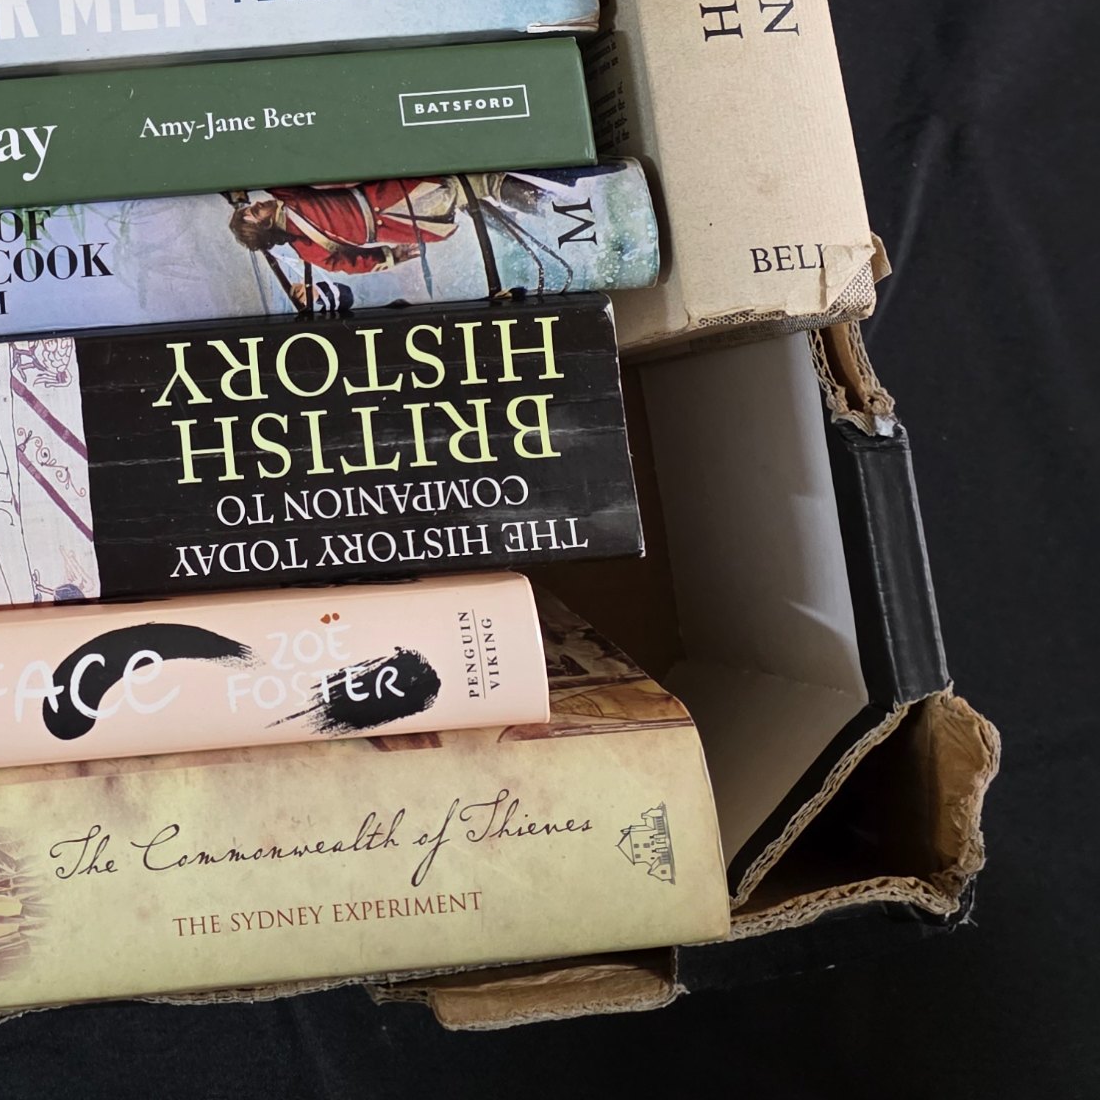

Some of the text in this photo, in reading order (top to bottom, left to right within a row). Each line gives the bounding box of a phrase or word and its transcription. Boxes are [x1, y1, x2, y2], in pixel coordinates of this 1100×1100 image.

[139, 107, 316, 143] Amy-Jane Beer
[414, 96, 515, 115] BATSFORD
[558, 199, 598, 247] M
[152, 316, 564, 408] HISTORY
[171, 393, 562, 485] BRITISH
[216, 475, 529, 527] COMPANION TO
[170, 516, 589, 578] THE HISTORY TODAY
[457, 609, 480, 699] PENGUIN
[481, 617, 501, 691] VIKING
[226, 664, 405, 715] FOSTER
[49, 789, 593, 887] The Commonwealth of Thieves
[173, 891, 482, 938] THE SYDNEY EXPERIMENT
